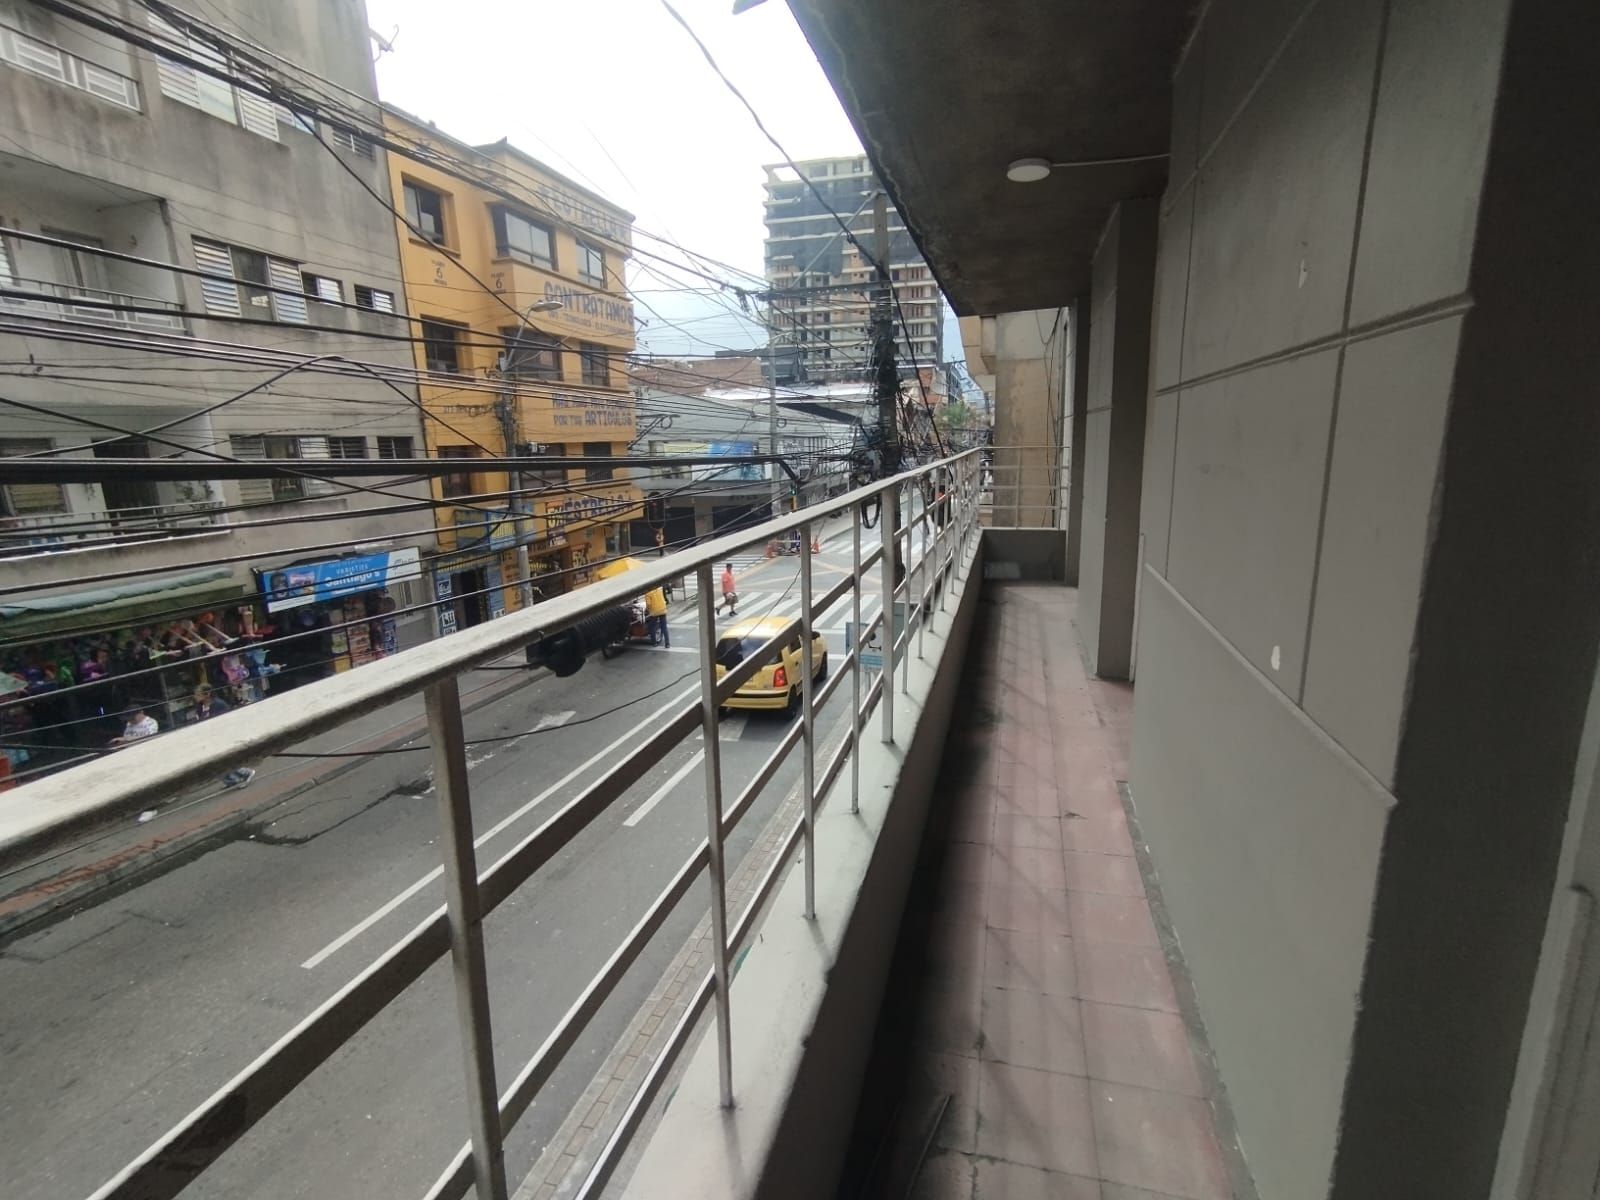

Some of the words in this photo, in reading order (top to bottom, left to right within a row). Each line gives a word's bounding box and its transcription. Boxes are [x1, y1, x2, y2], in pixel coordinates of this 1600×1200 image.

[495, 278, 503, 289] 6
[544, 281, 634, 326] CONTRATAMOS
[584, 410, 632, 427] ARTICULOS
